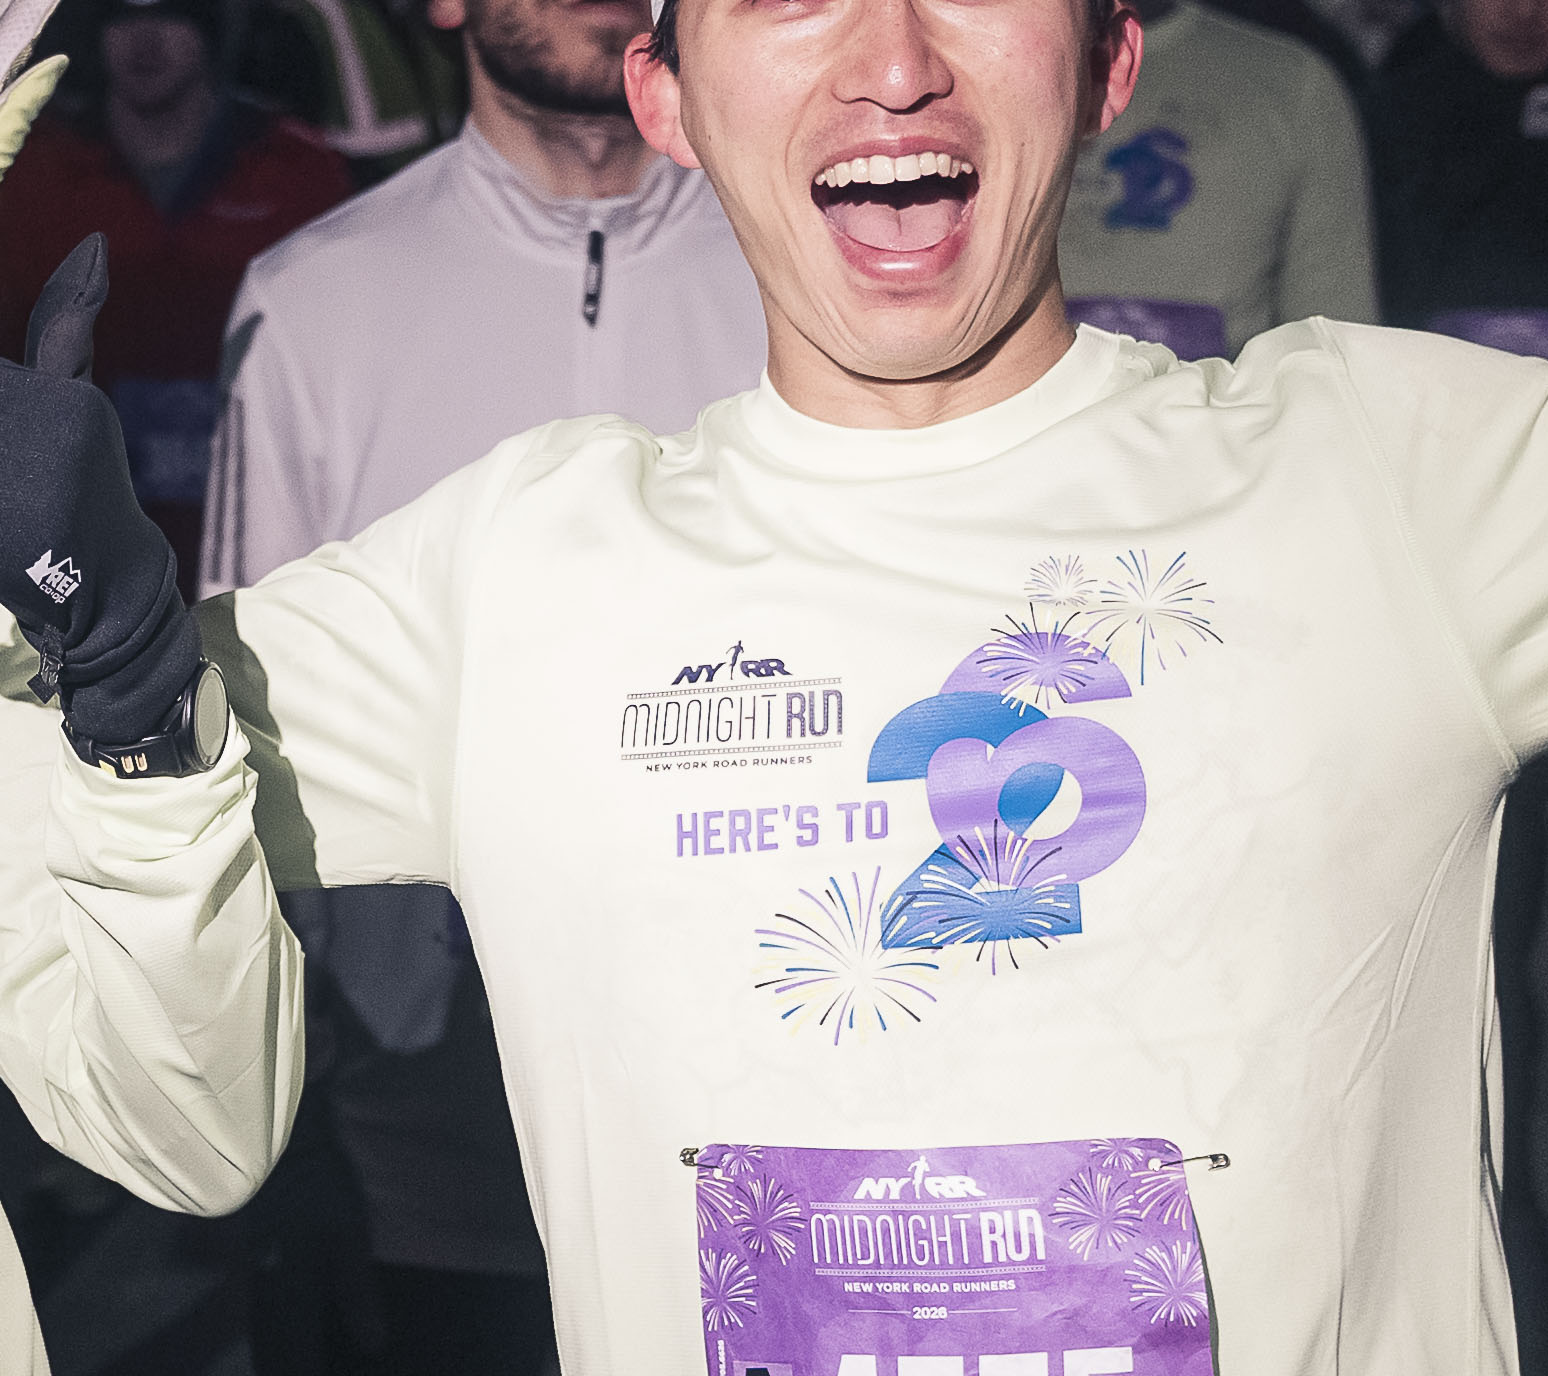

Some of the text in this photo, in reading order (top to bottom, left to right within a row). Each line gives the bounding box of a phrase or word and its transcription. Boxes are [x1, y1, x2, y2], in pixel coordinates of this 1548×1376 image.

[45, 571, 80, 598] REI
[620, 689, 843, 748] MIDNIGHT RUN
[645, 755, 813, 773] NEW YORK ROAD RUNNERS
[675, 799, 890, 858] HERE'S TO
[810, 1208, 1046, 1266] MIDNIGHT RUN
[843, 1279, 1017, 1293] NEW YORK ROAD RUNNERS
[912, 1306, 948, 1320] 2026
